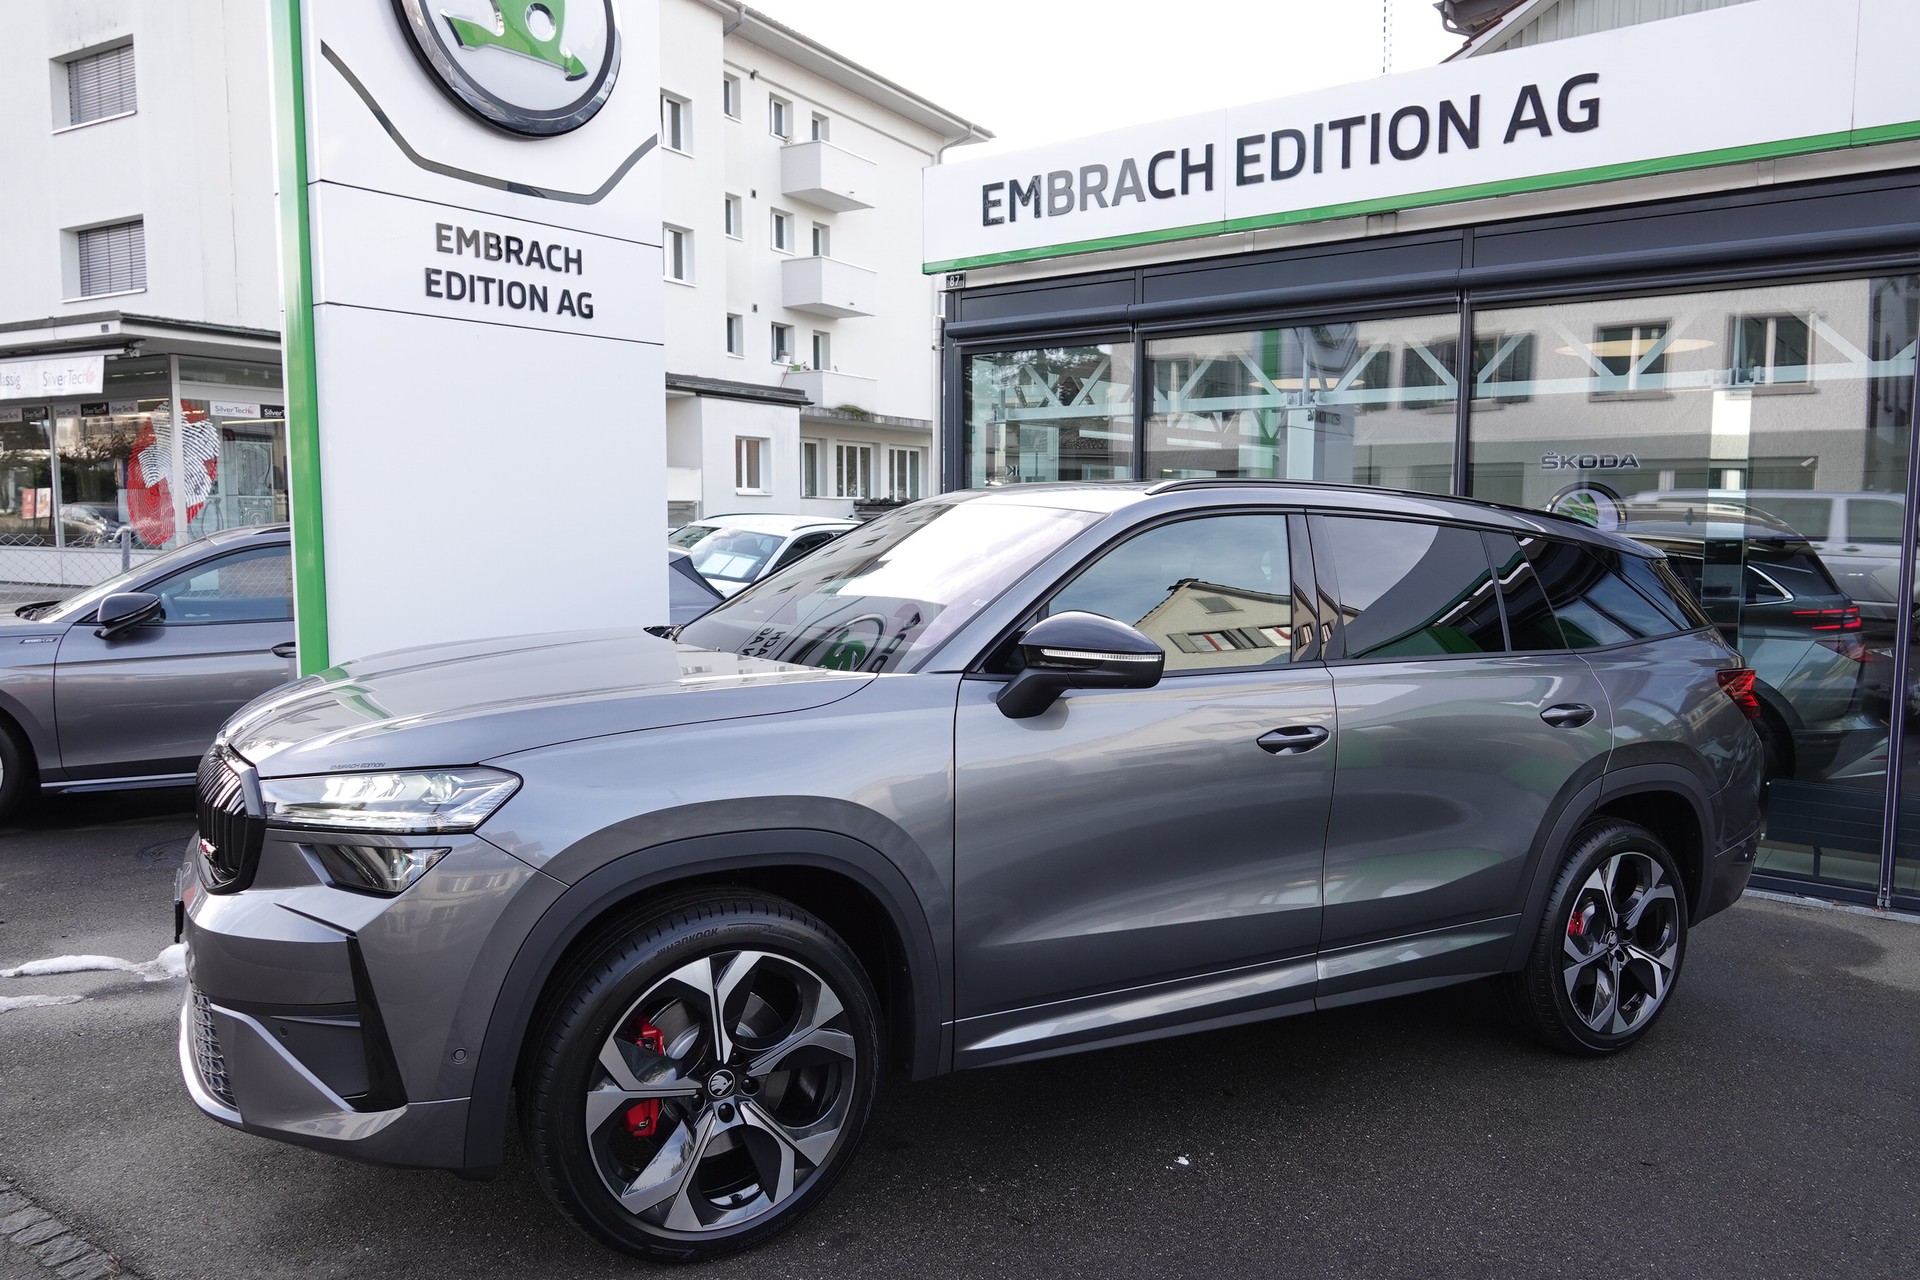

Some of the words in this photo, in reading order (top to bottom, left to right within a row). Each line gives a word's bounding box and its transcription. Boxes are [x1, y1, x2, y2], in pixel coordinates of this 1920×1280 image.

[981, 142, 1214, 227] EMBRACH
[1235, 93, 1481, 186] EDITION
[1503, 72, 1600, 144] AG
[435, 222, 583, 275] EMBRACH
[425, 267, 549, 313] EDITION
[556, 289, 594, 319] AG
[950, 275, 960, 287] 87
[215, 404, 250, 415] SilverTech
[1541, 451, 1641, 470] ŠKODA
